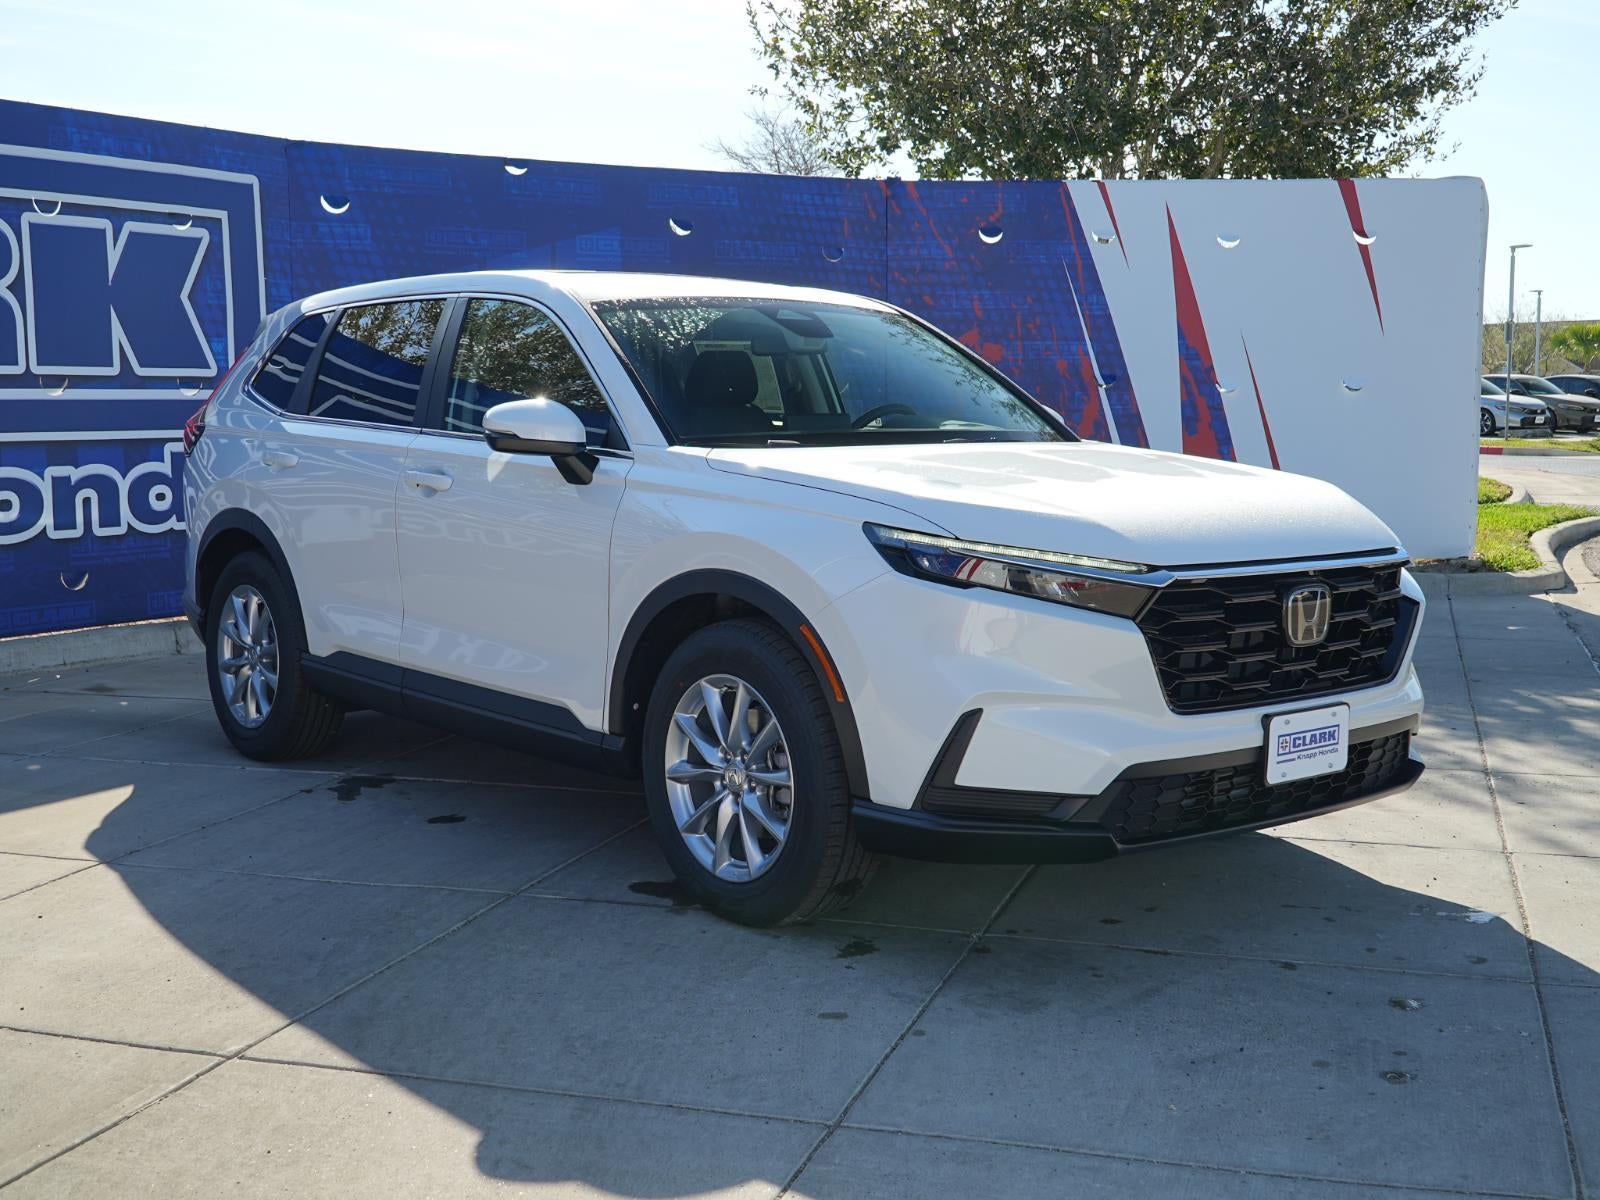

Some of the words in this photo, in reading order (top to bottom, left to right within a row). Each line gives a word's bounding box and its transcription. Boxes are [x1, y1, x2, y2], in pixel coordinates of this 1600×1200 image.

[1292, 729, 1337, 749] CLARK
[1296, 752, 1318, 761] Knapp
[1318, 747, 1339, 757] Honda
